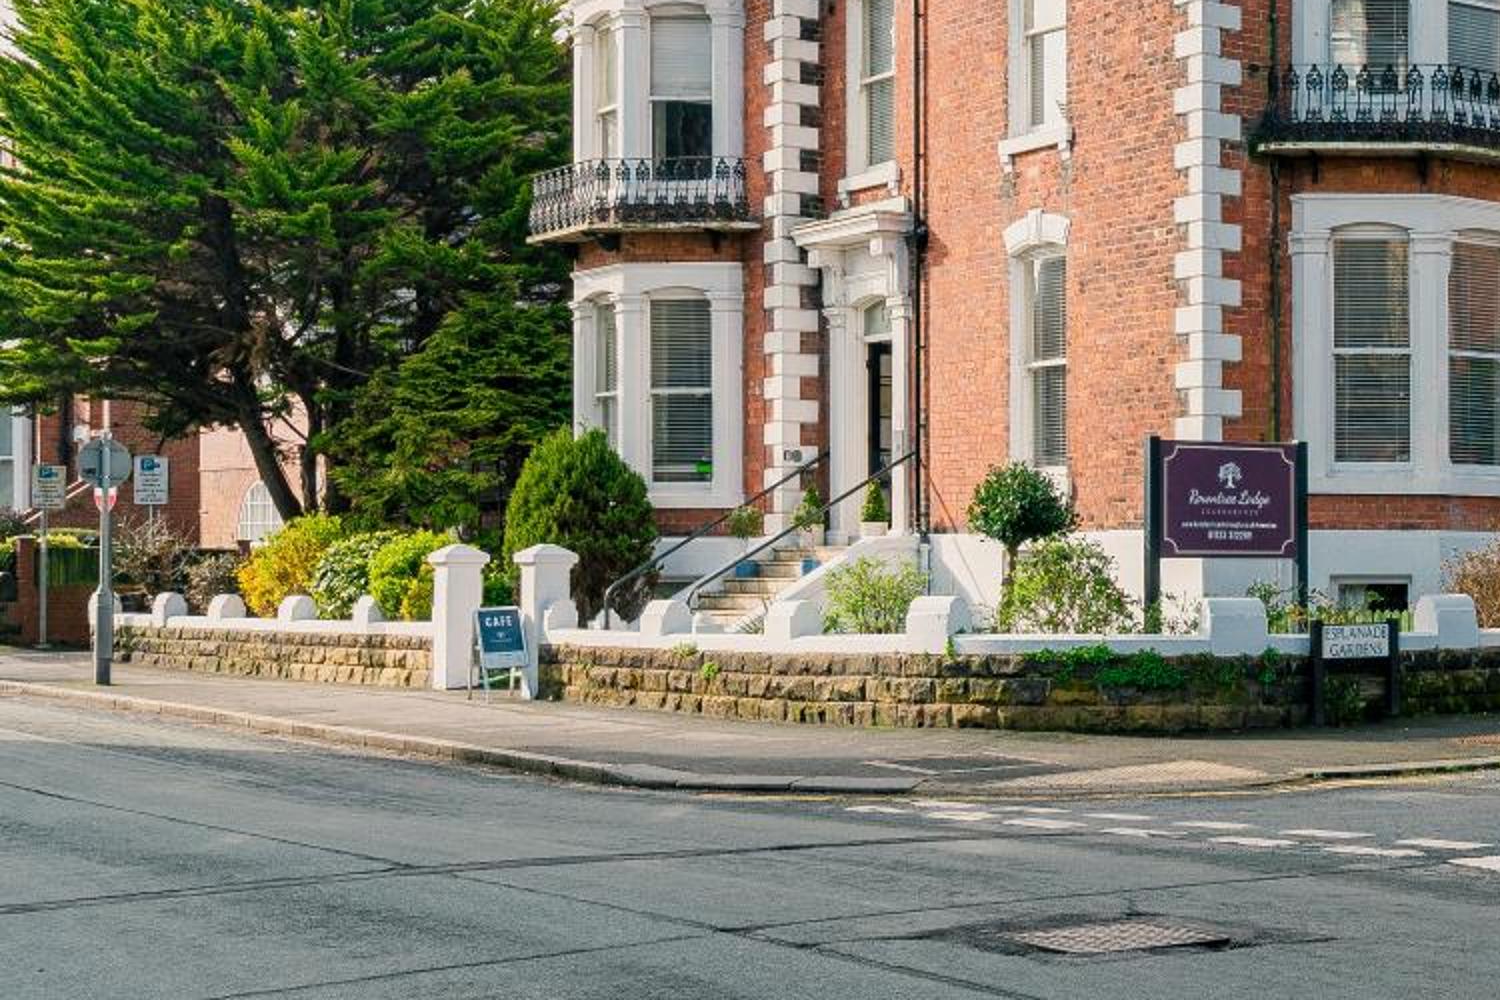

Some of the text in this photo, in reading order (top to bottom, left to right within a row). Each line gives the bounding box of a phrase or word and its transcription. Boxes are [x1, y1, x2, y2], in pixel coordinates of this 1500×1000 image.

[1238, 489, 1270, 509] Lodge
[485, 615, 512, 627] CAFE
[1325, 625, 1387, 641] ESPLANADE
[1329, 642, 1383, 657] GARDENS
